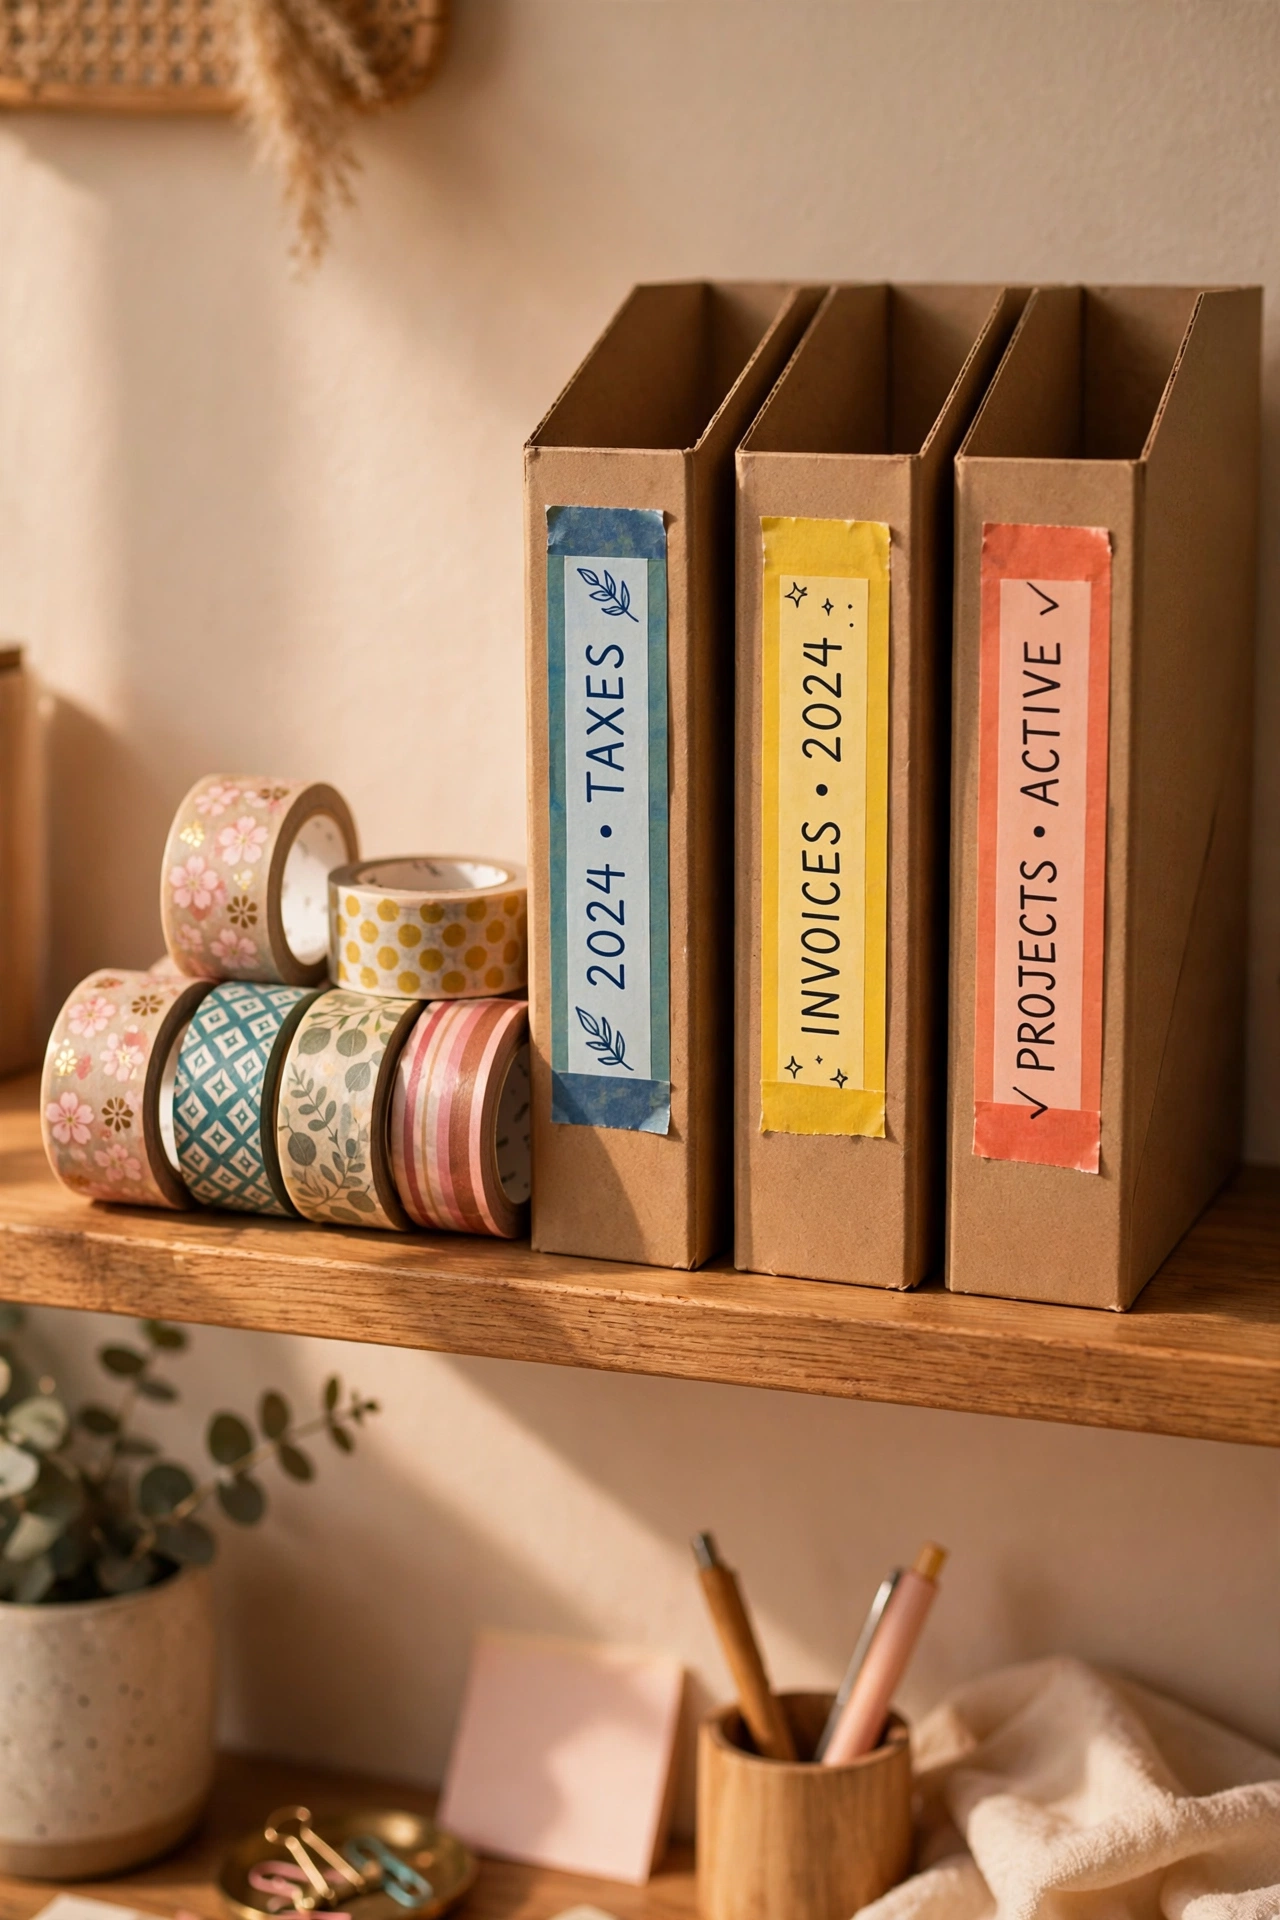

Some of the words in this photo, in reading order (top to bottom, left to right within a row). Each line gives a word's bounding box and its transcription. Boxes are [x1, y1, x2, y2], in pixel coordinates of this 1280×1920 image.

[585, 644, 625, 803] TAXES
[801, 637, 843, 763] 2024
[1019, 641, 1062, 807] ACTIVE
[585, 863, 626, 990] 2024
[800, 821, 841, 1036] INVOICES
[1016, 860, 1058, 1072] PROJECTS
